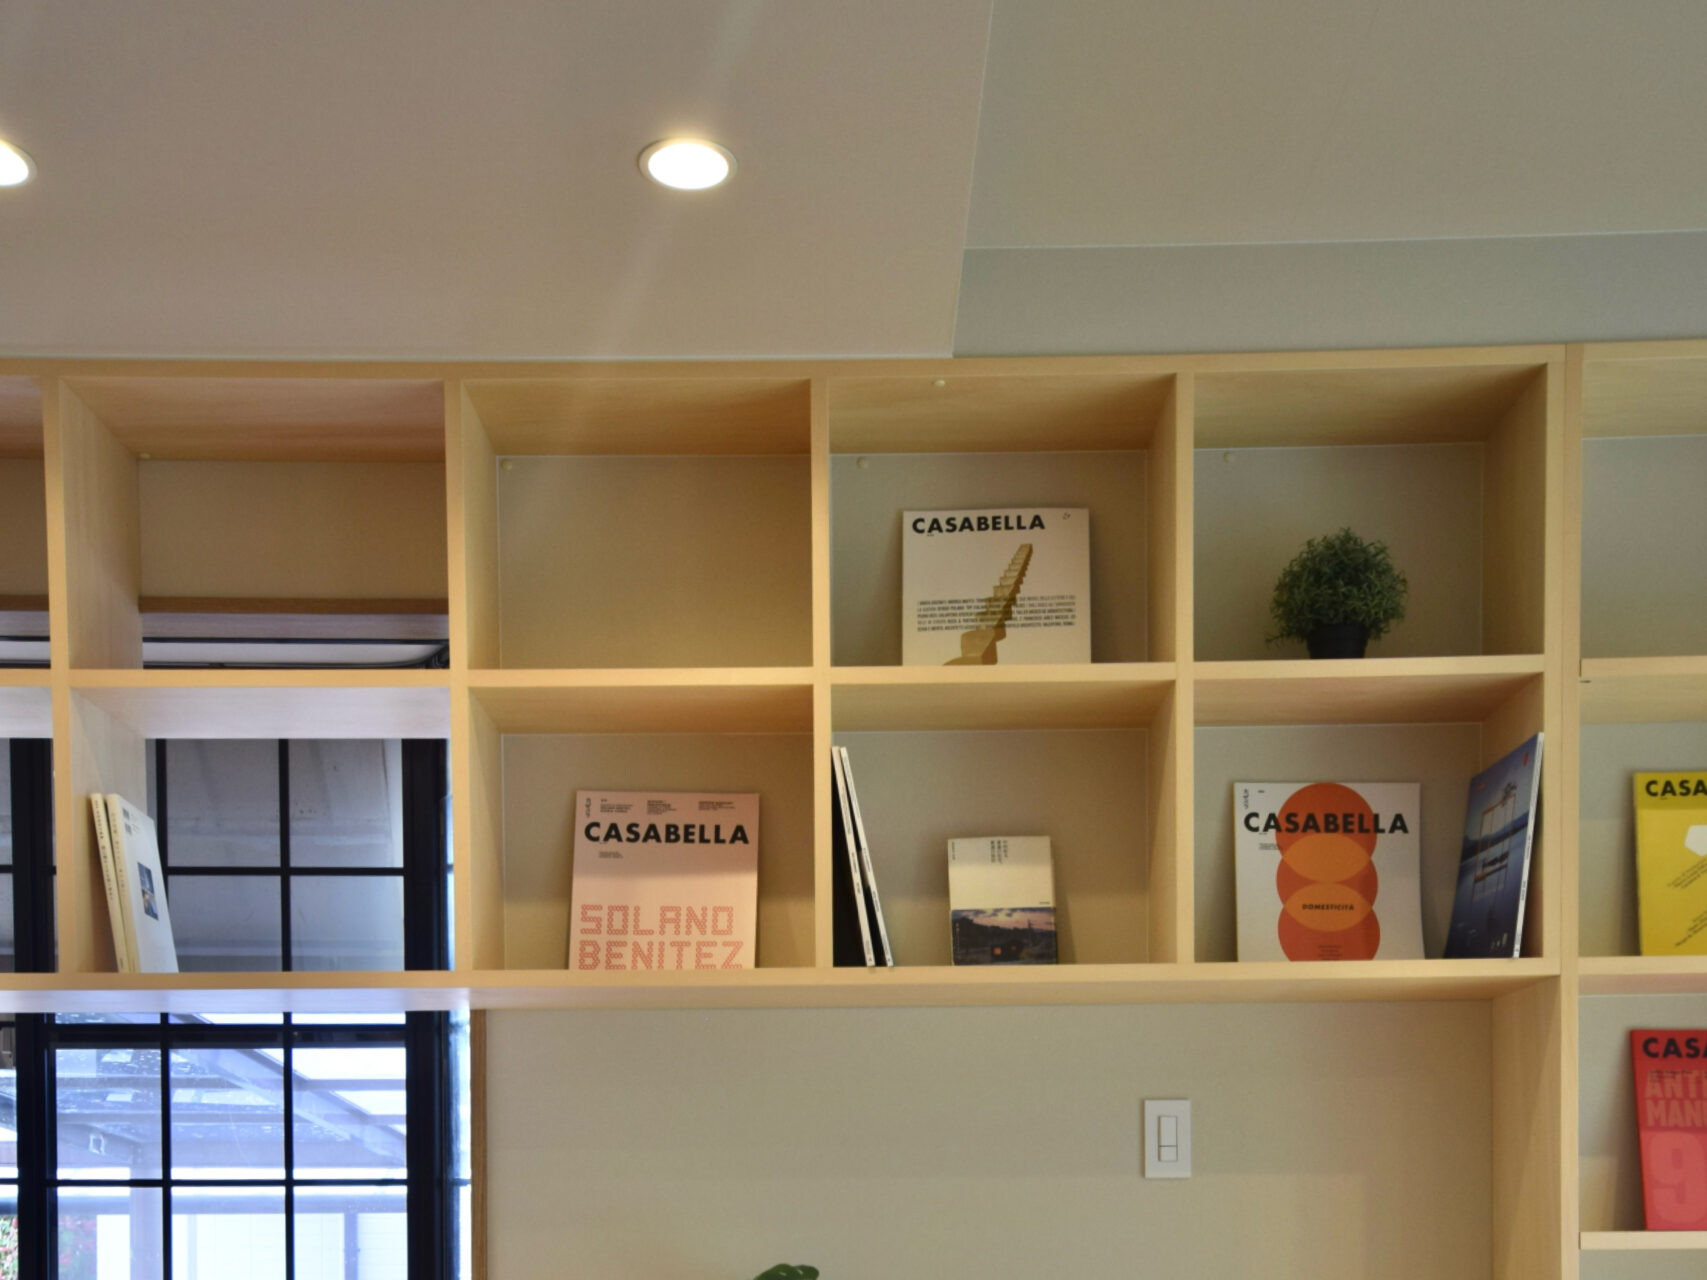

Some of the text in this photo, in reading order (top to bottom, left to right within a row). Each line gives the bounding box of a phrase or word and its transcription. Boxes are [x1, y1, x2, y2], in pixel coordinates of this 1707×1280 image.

[912, 514, 1046, 534] CASABELLA
[584, 821, 750, 845] CASABELLA
[1243, 811, 1409, 834] CASABELLA
[580, 904, 734, 936] SOLANO
[578, 939, 744, 971] BENITEZ
[1642, 1037, 1707, 1059] CAS
